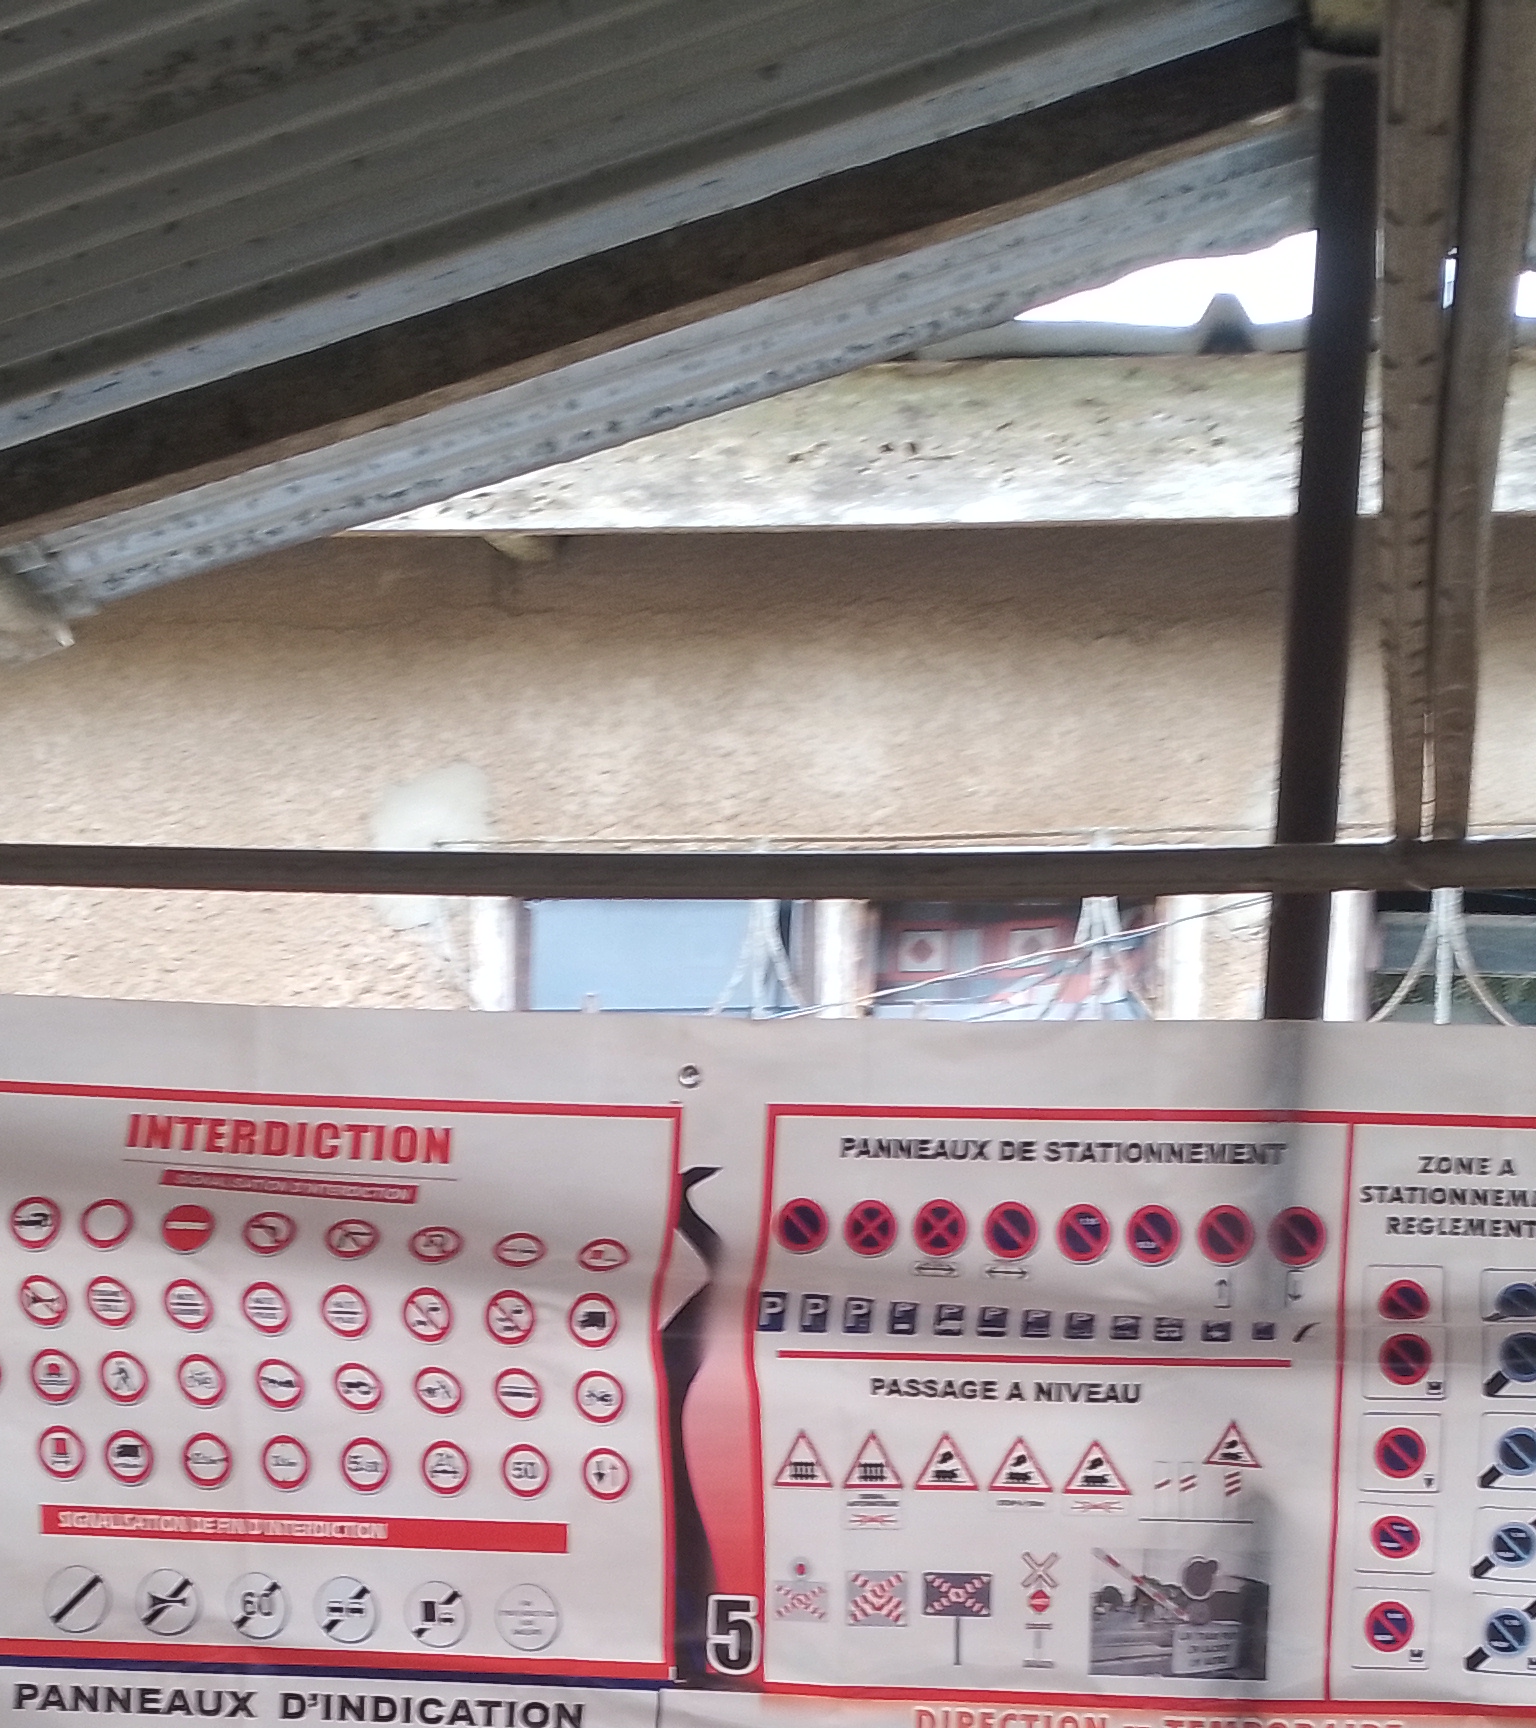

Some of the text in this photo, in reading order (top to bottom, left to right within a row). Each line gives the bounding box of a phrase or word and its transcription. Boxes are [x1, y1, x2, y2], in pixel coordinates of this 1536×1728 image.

[125, 1113, 453, 1164] INTERDICTION
[839, 1136, 1288, 1166] PANNEAUX DE STATIONNEMENT
[1417, 1155, 1518, 1178] ZONE A
[869, 1376, 1143, 1404] PASSAGE A NIVEAU
[708, 1598, 759, 1671] 5
[11, 1683, 260, 1720] PANNEAUX
